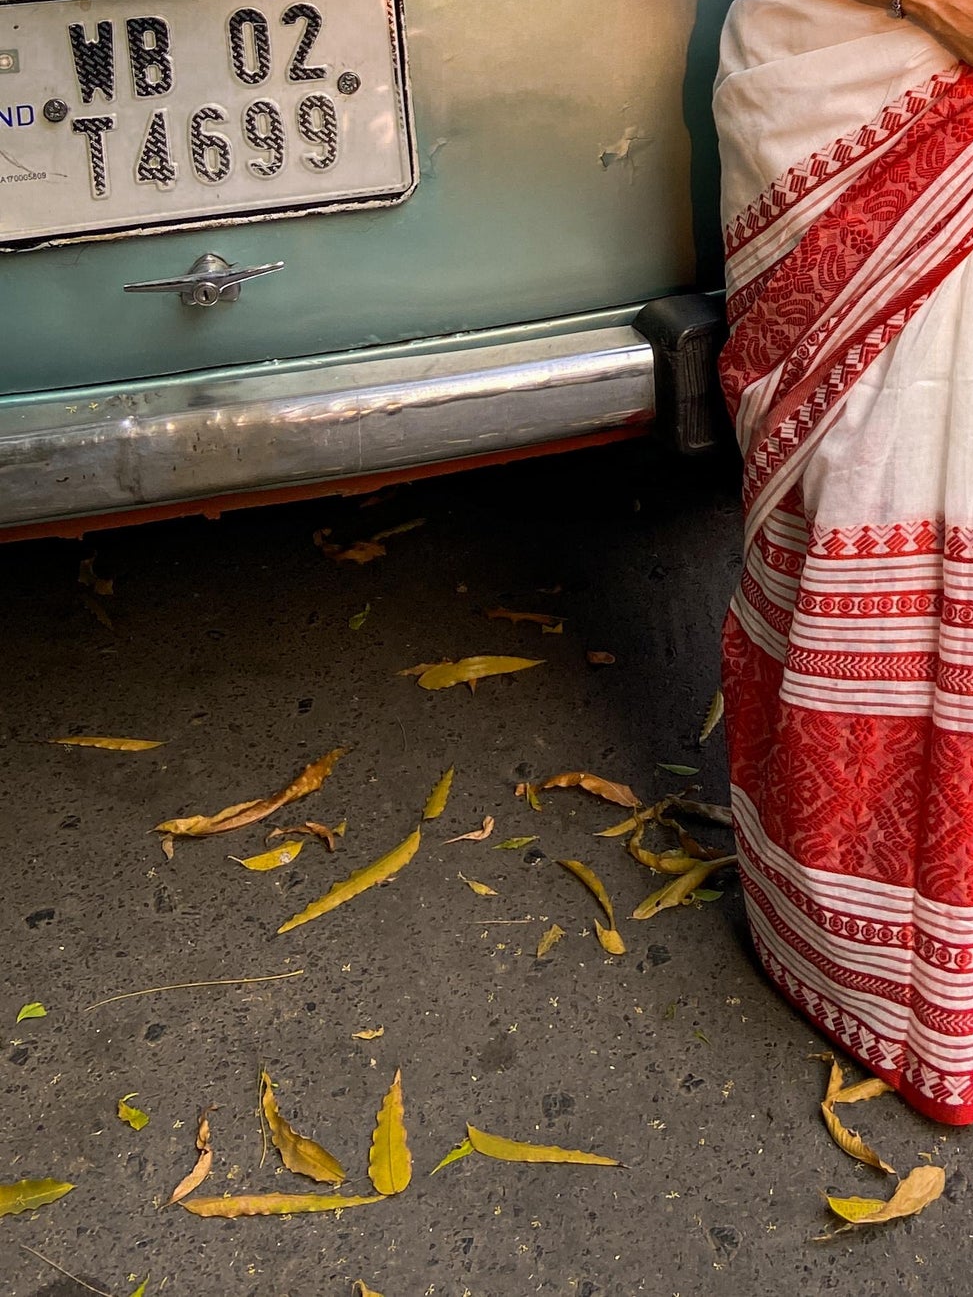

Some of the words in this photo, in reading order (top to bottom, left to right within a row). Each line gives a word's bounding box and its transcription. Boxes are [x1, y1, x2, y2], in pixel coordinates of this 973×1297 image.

[68, 15, 174, 104] WB
[227, 2, 330, 86] 02
[72, 92, 343, 200] T4699
